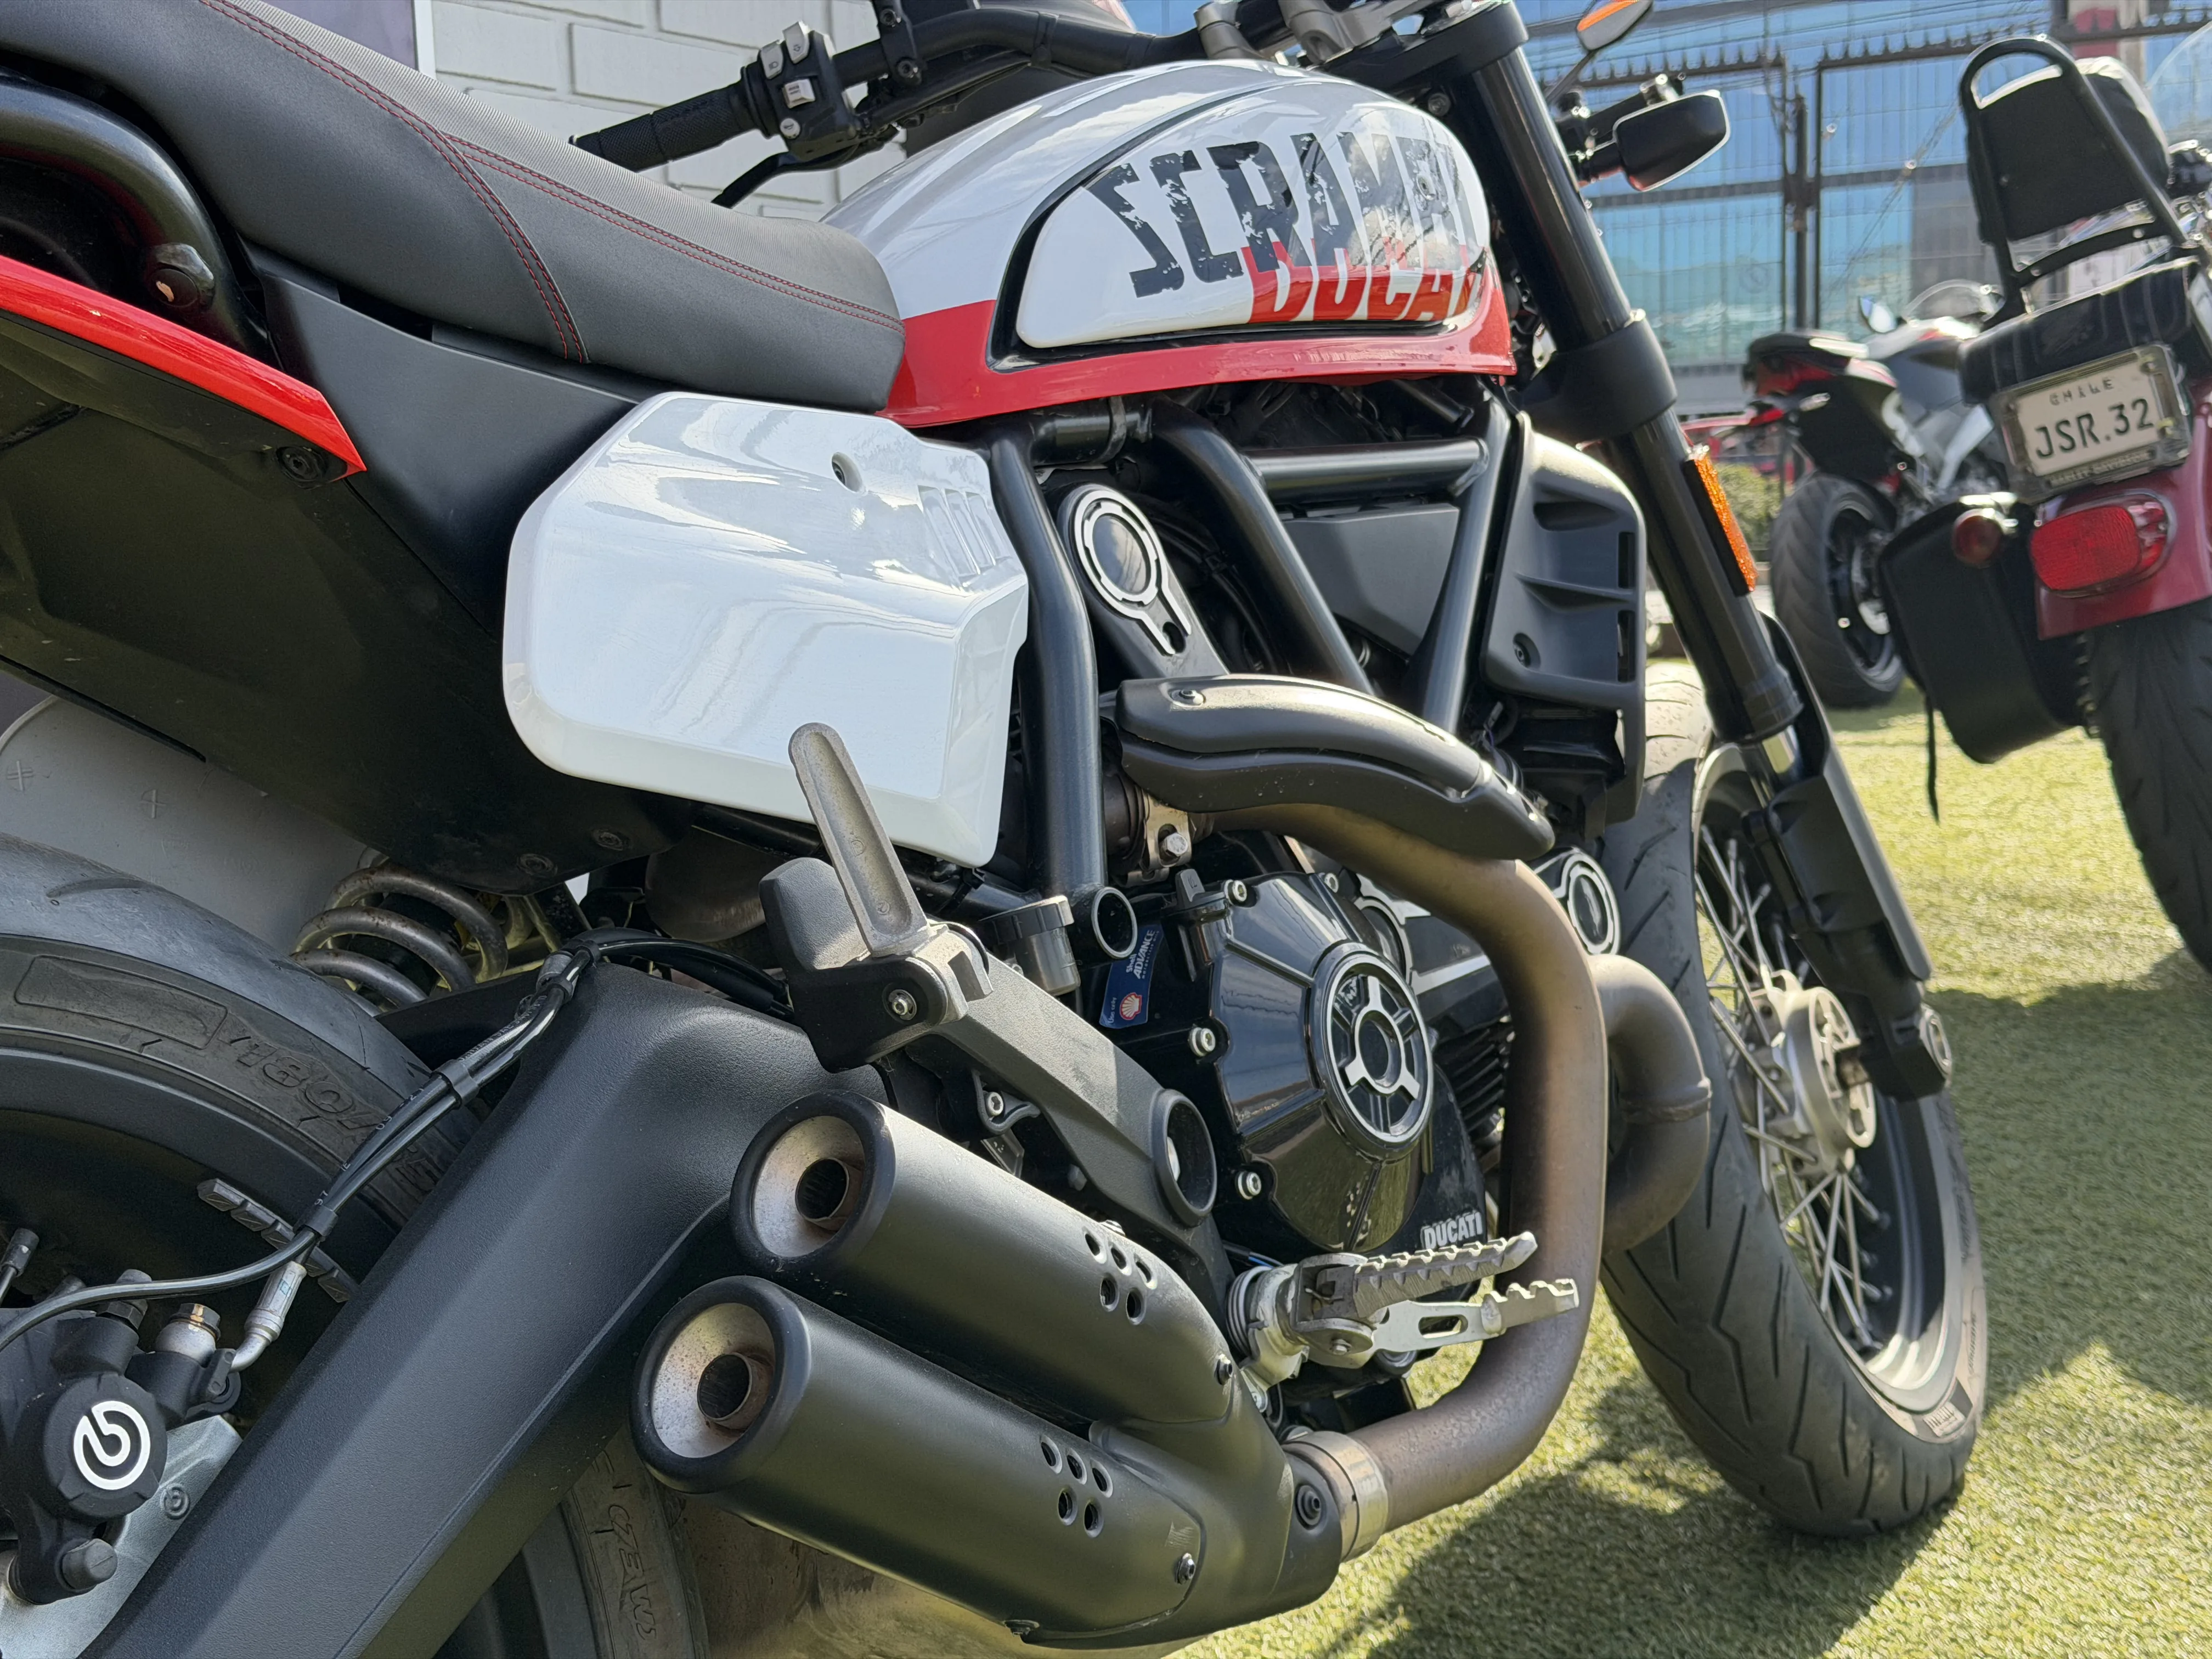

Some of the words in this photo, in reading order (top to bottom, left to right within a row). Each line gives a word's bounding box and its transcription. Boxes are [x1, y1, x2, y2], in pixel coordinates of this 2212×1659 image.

[2049, 379, 2114, 405] CHILE
[1126, 953, 1137, 973] Shell
[1133, 930, 1156, 979] ADVANCE
[1424, 1210, 1483, 1250] DUCATI
